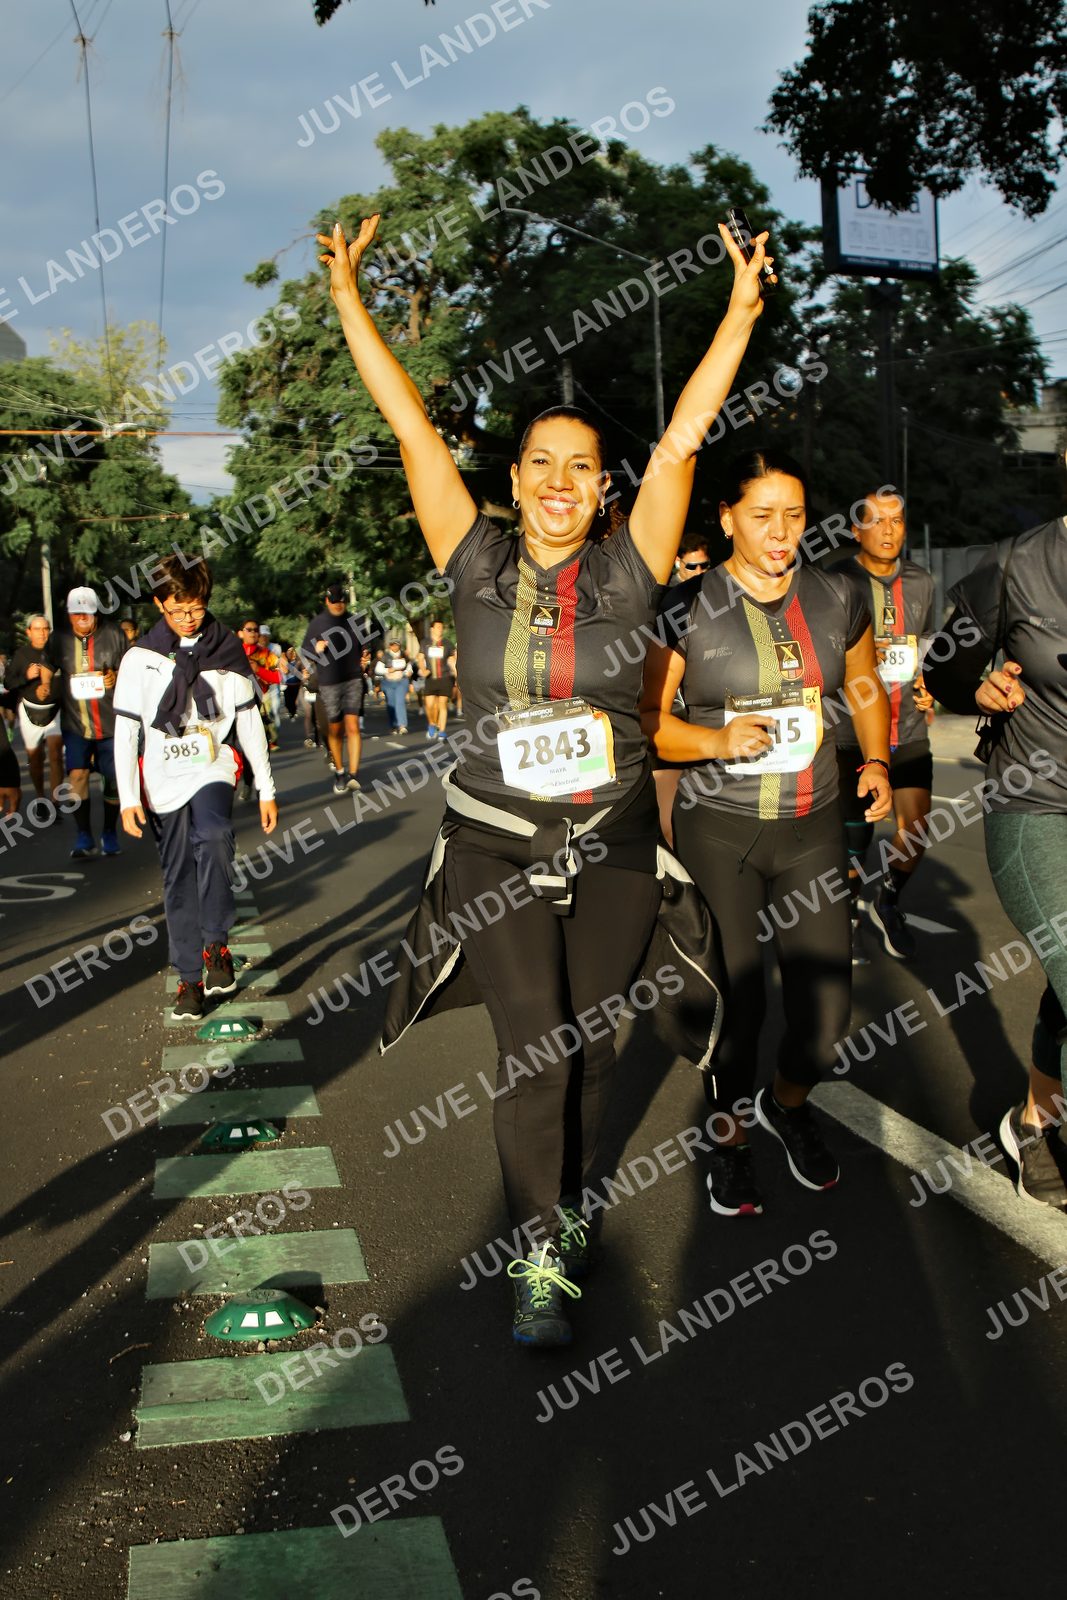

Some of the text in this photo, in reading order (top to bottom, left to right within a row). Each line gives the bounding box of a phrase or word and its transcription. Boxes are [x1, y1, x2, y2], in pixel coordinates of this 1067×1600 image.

[884, 650, 905, 666] 85
[775, 717, 801, 744] 15
[514, 727, 591, 770] 2843
